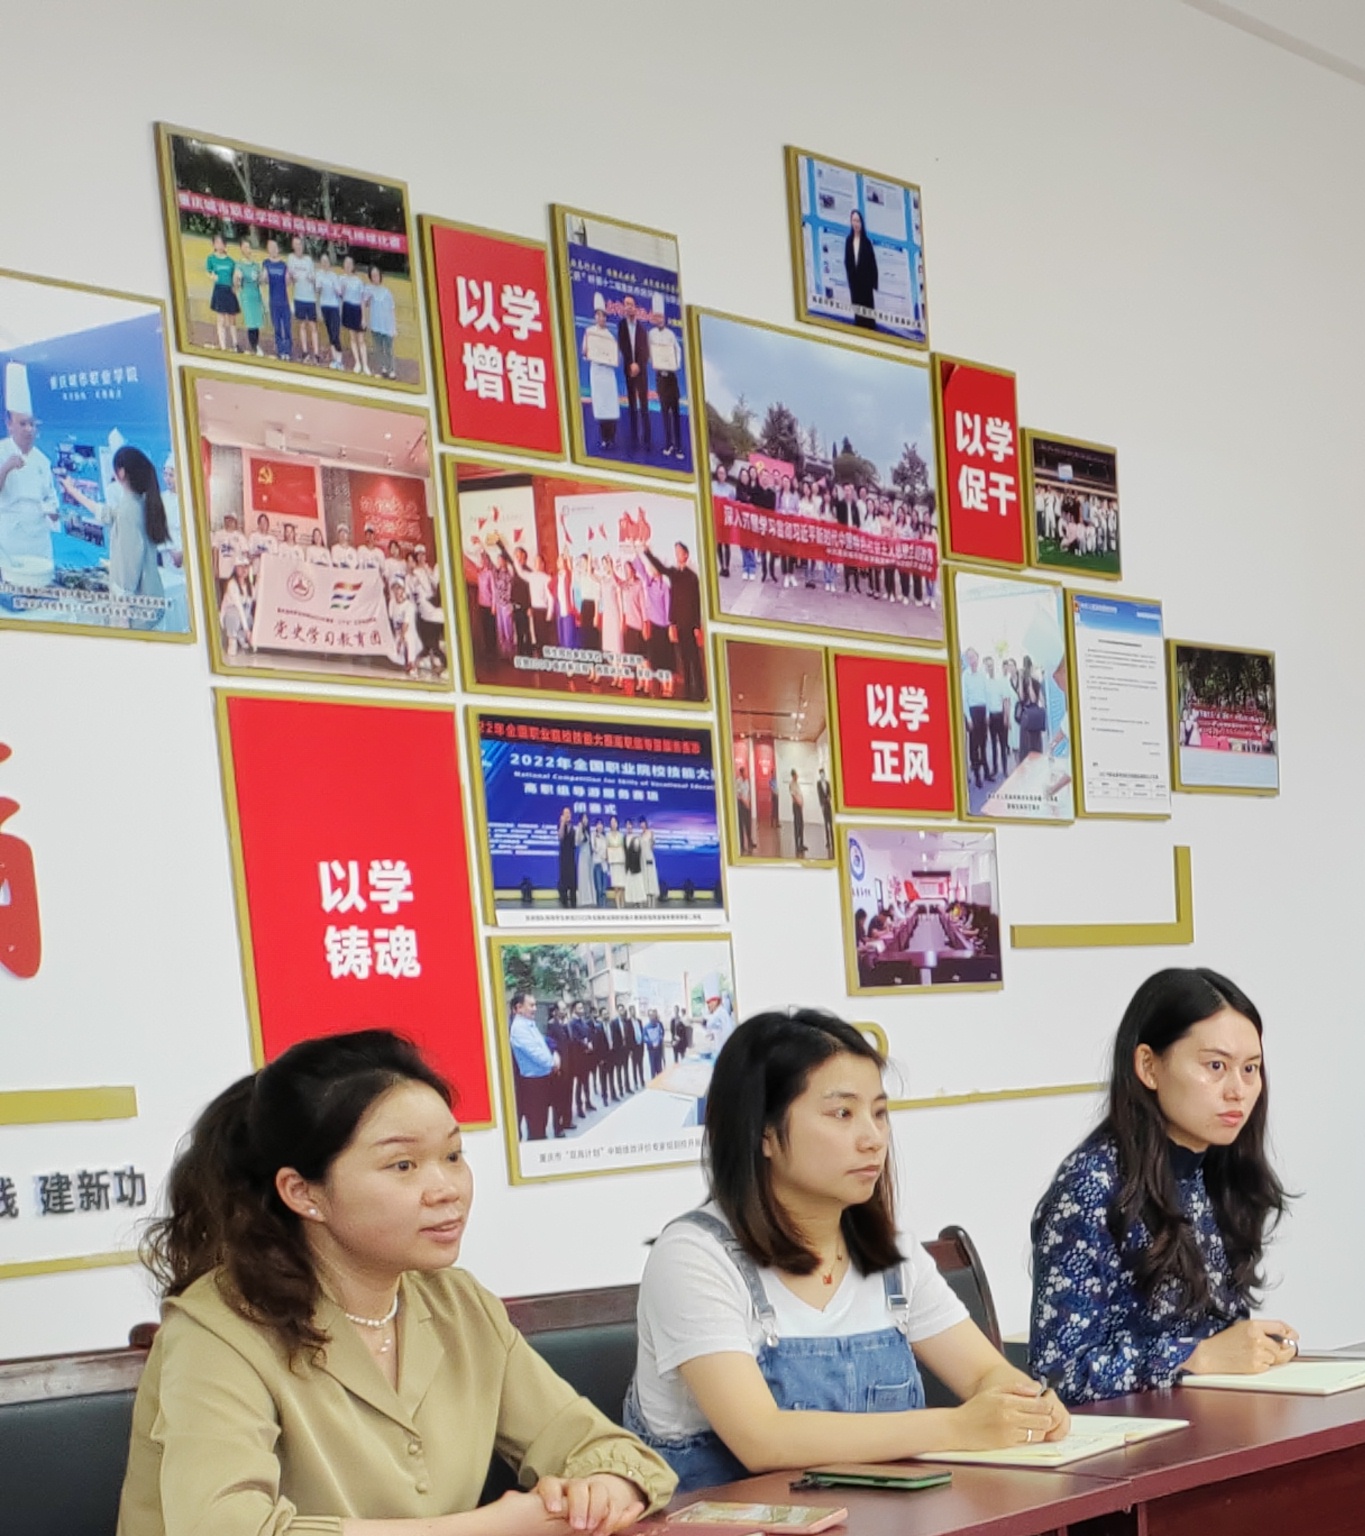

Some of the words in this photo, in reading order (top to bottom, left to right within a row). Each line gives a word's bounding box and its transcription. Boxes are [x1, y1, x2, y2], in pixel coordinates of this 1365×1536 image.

[456, 275, 543, 341] 以学
[462, 342, 547, 410] 增智
[954, 409, 1014, 463] 以学
[958, 464, 1018, 516] 促干
[866, 683, 929, 731] 以学
[510, 753, 715, 781] 2022年全国职业院校技能大
[870, 741, 933, 785] 正风
[319, 860, 414, 914] 以学
[324, 926, 421, 980] 铸魂
[38, 1165, 147, 1216] 建新功
